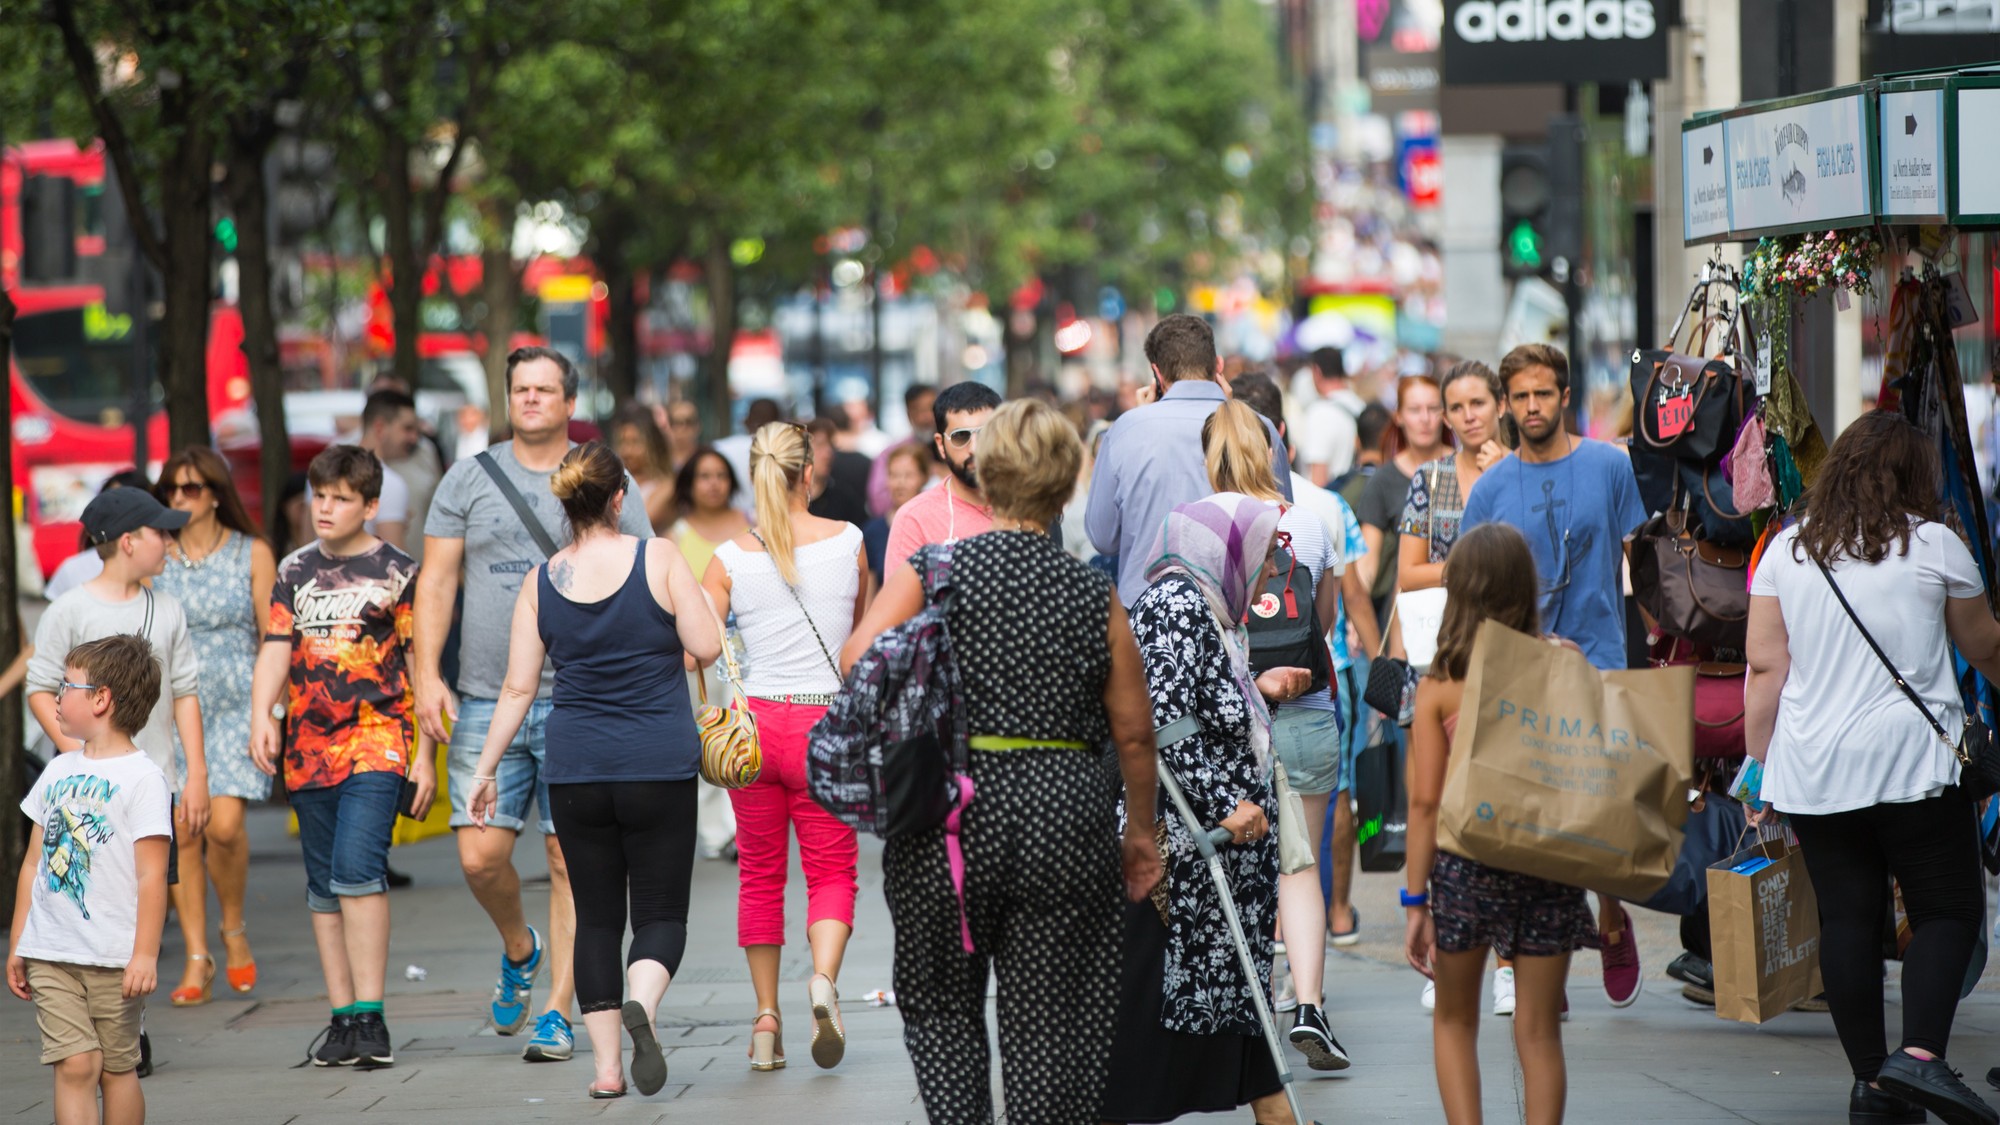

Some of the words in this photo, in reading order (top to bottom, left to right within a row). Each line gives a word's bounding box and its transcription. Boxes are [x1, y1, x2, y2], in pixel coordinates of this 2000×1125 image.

[1454, 0, 1656, 43] adidas
[1793, 123, 1809, 155] CHIPPY
[1736, 159, 1749, 190] FISH
[1754, 156, 1771, 187] CHIPS
[1816, 146, 1831, 178] FISH
[1836, 142, 1855, 175] CHIPS
[1662, 405, 1691, 427] £10
[331, 629, 357, 639] TOUR
[1499, 699, 1653, 755] PRIMARK
[1521, 734, 1579, 757] OXFORD
[1583, 747, 1631, 764] STREET
[74, 813, 114, 844] POW
[1758, 869, 1790, 897] ONLY
[1760, 889, 1786, 914] THE
[1762, 901, 1793, 930] BEST
[1764, 921, 1788, 946] FOR
[1764, 935, 1789, 961] THE
[1765, 936, 1817, 978] ATHLETE
